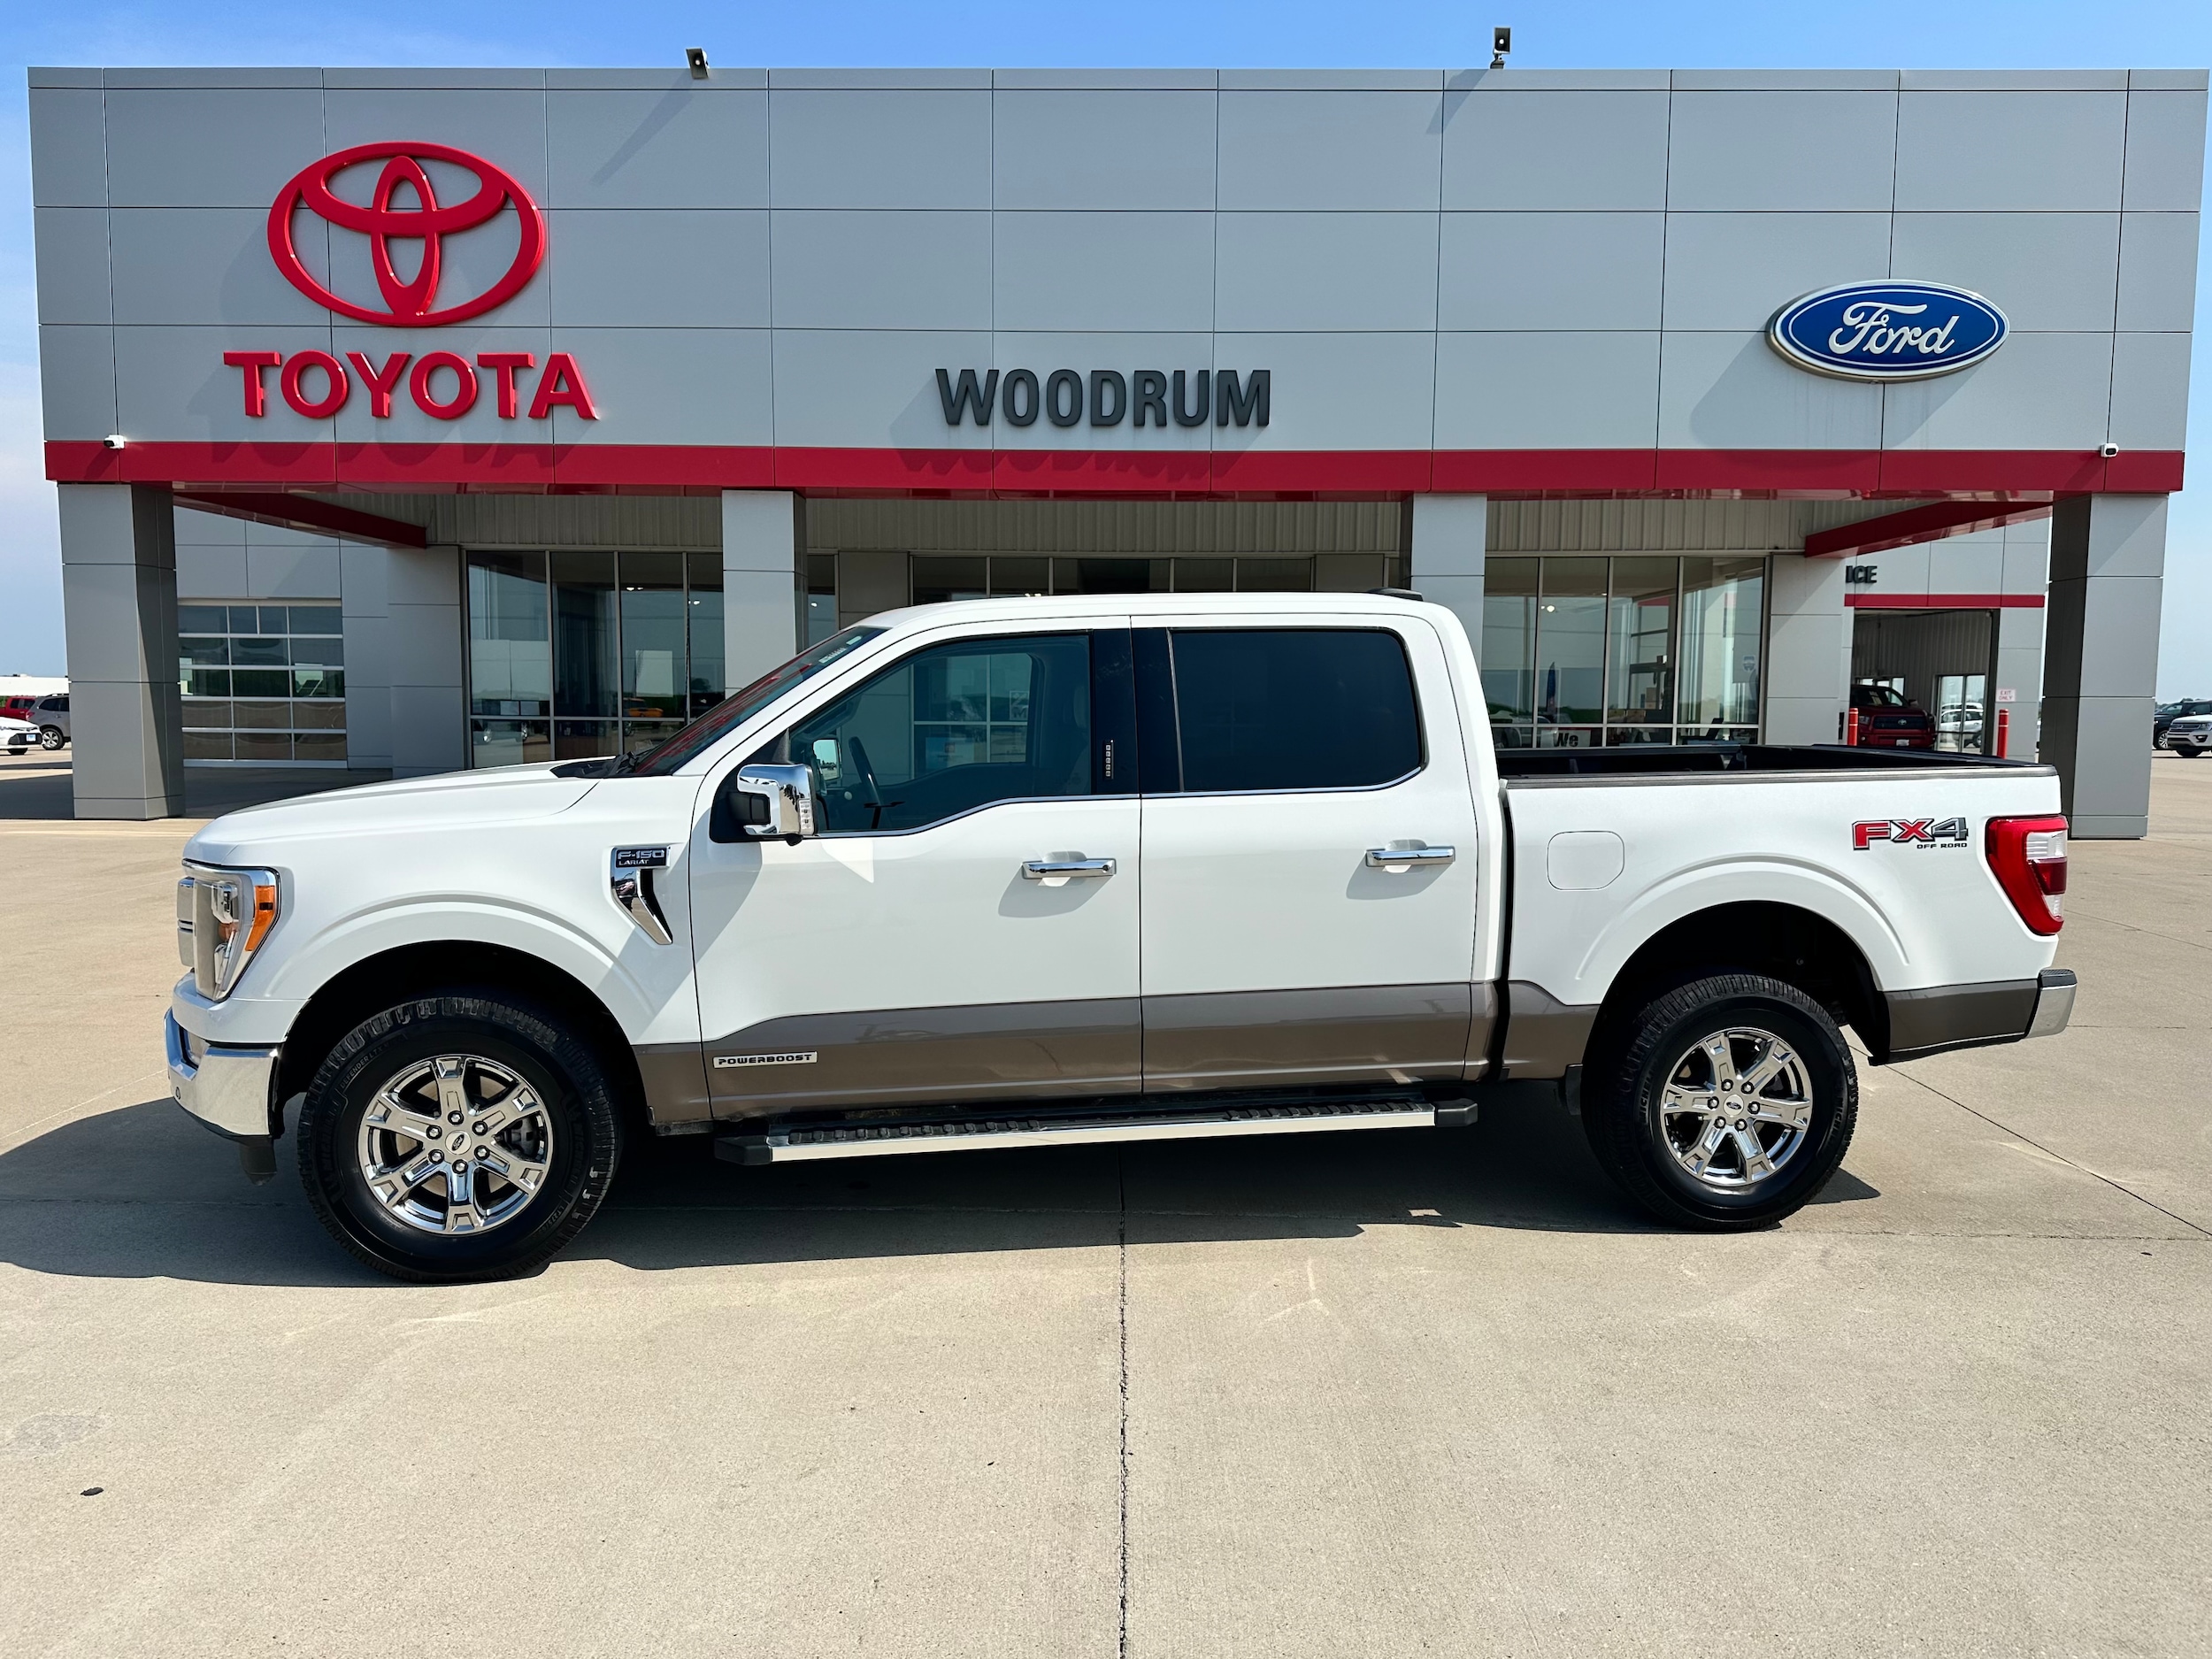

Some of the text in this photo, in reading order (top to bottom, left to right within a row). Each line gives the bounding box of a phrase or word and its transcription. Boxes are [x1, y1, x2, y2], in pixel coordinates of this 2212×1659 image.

[1828, 302, 1959, 355] Ford
[224, 349, 599, 420] TOYOTA
[935, 369, 1271, 427] WOODRUM
[1846, 565, 1877, 583] ICE
[1554, 733, 1578, 747] We
[1852, 817, 1969, 850] FX4
[618, 849, 664, 859] F-150
[339, 1056, 369, 1089] DEFENDER
[718, 1054, 812, 1065] POWERBOOST
